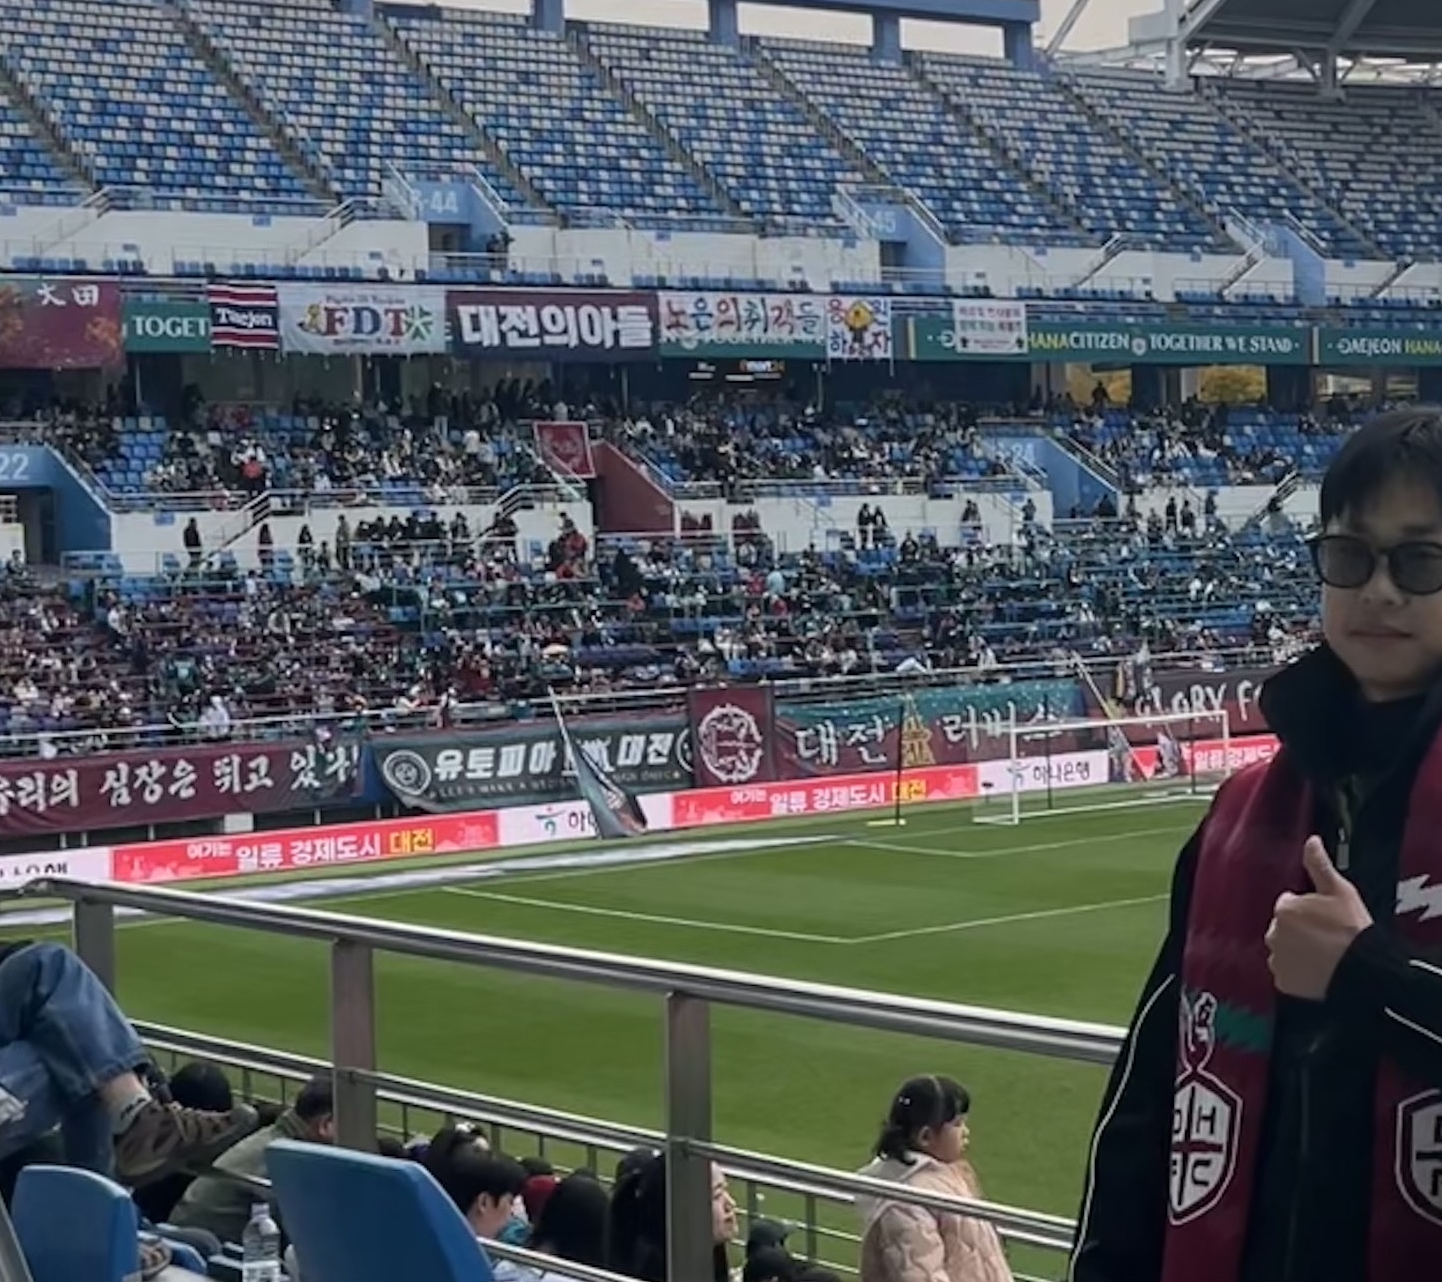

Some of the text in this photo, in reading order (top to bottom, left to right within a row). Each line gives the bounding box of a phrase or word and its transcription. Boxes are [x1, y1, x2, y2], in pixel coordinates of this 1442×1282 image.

[323, 306, 409, 337] FDT
[456, 304, 654, 349] 대전의아들
[1149, 332, 1223, 352] TOGETHER
[1225, 335, 1247, 354] WE
[1249, 335, 1294, 354] STAND
[1336, 337, 1401, 357] DAEJEON
[434, 741, 557, 782] 유토피아
[616, 732, 675, 767] 대전
[795, 714, 894, 767] 대전
[99, 759, 198, 807] 심장은
[213, 753, 276, 795] 뛰고
[769, 790, 808, 814] 일류
[812, 781, 886, 810] 경제도시
[891, 779, 927, 800] 대전
[235, 844, 284, 872] 일류
[289, 833, 382, 866] 경제도시
[389, 828, 434, 854] 대전
